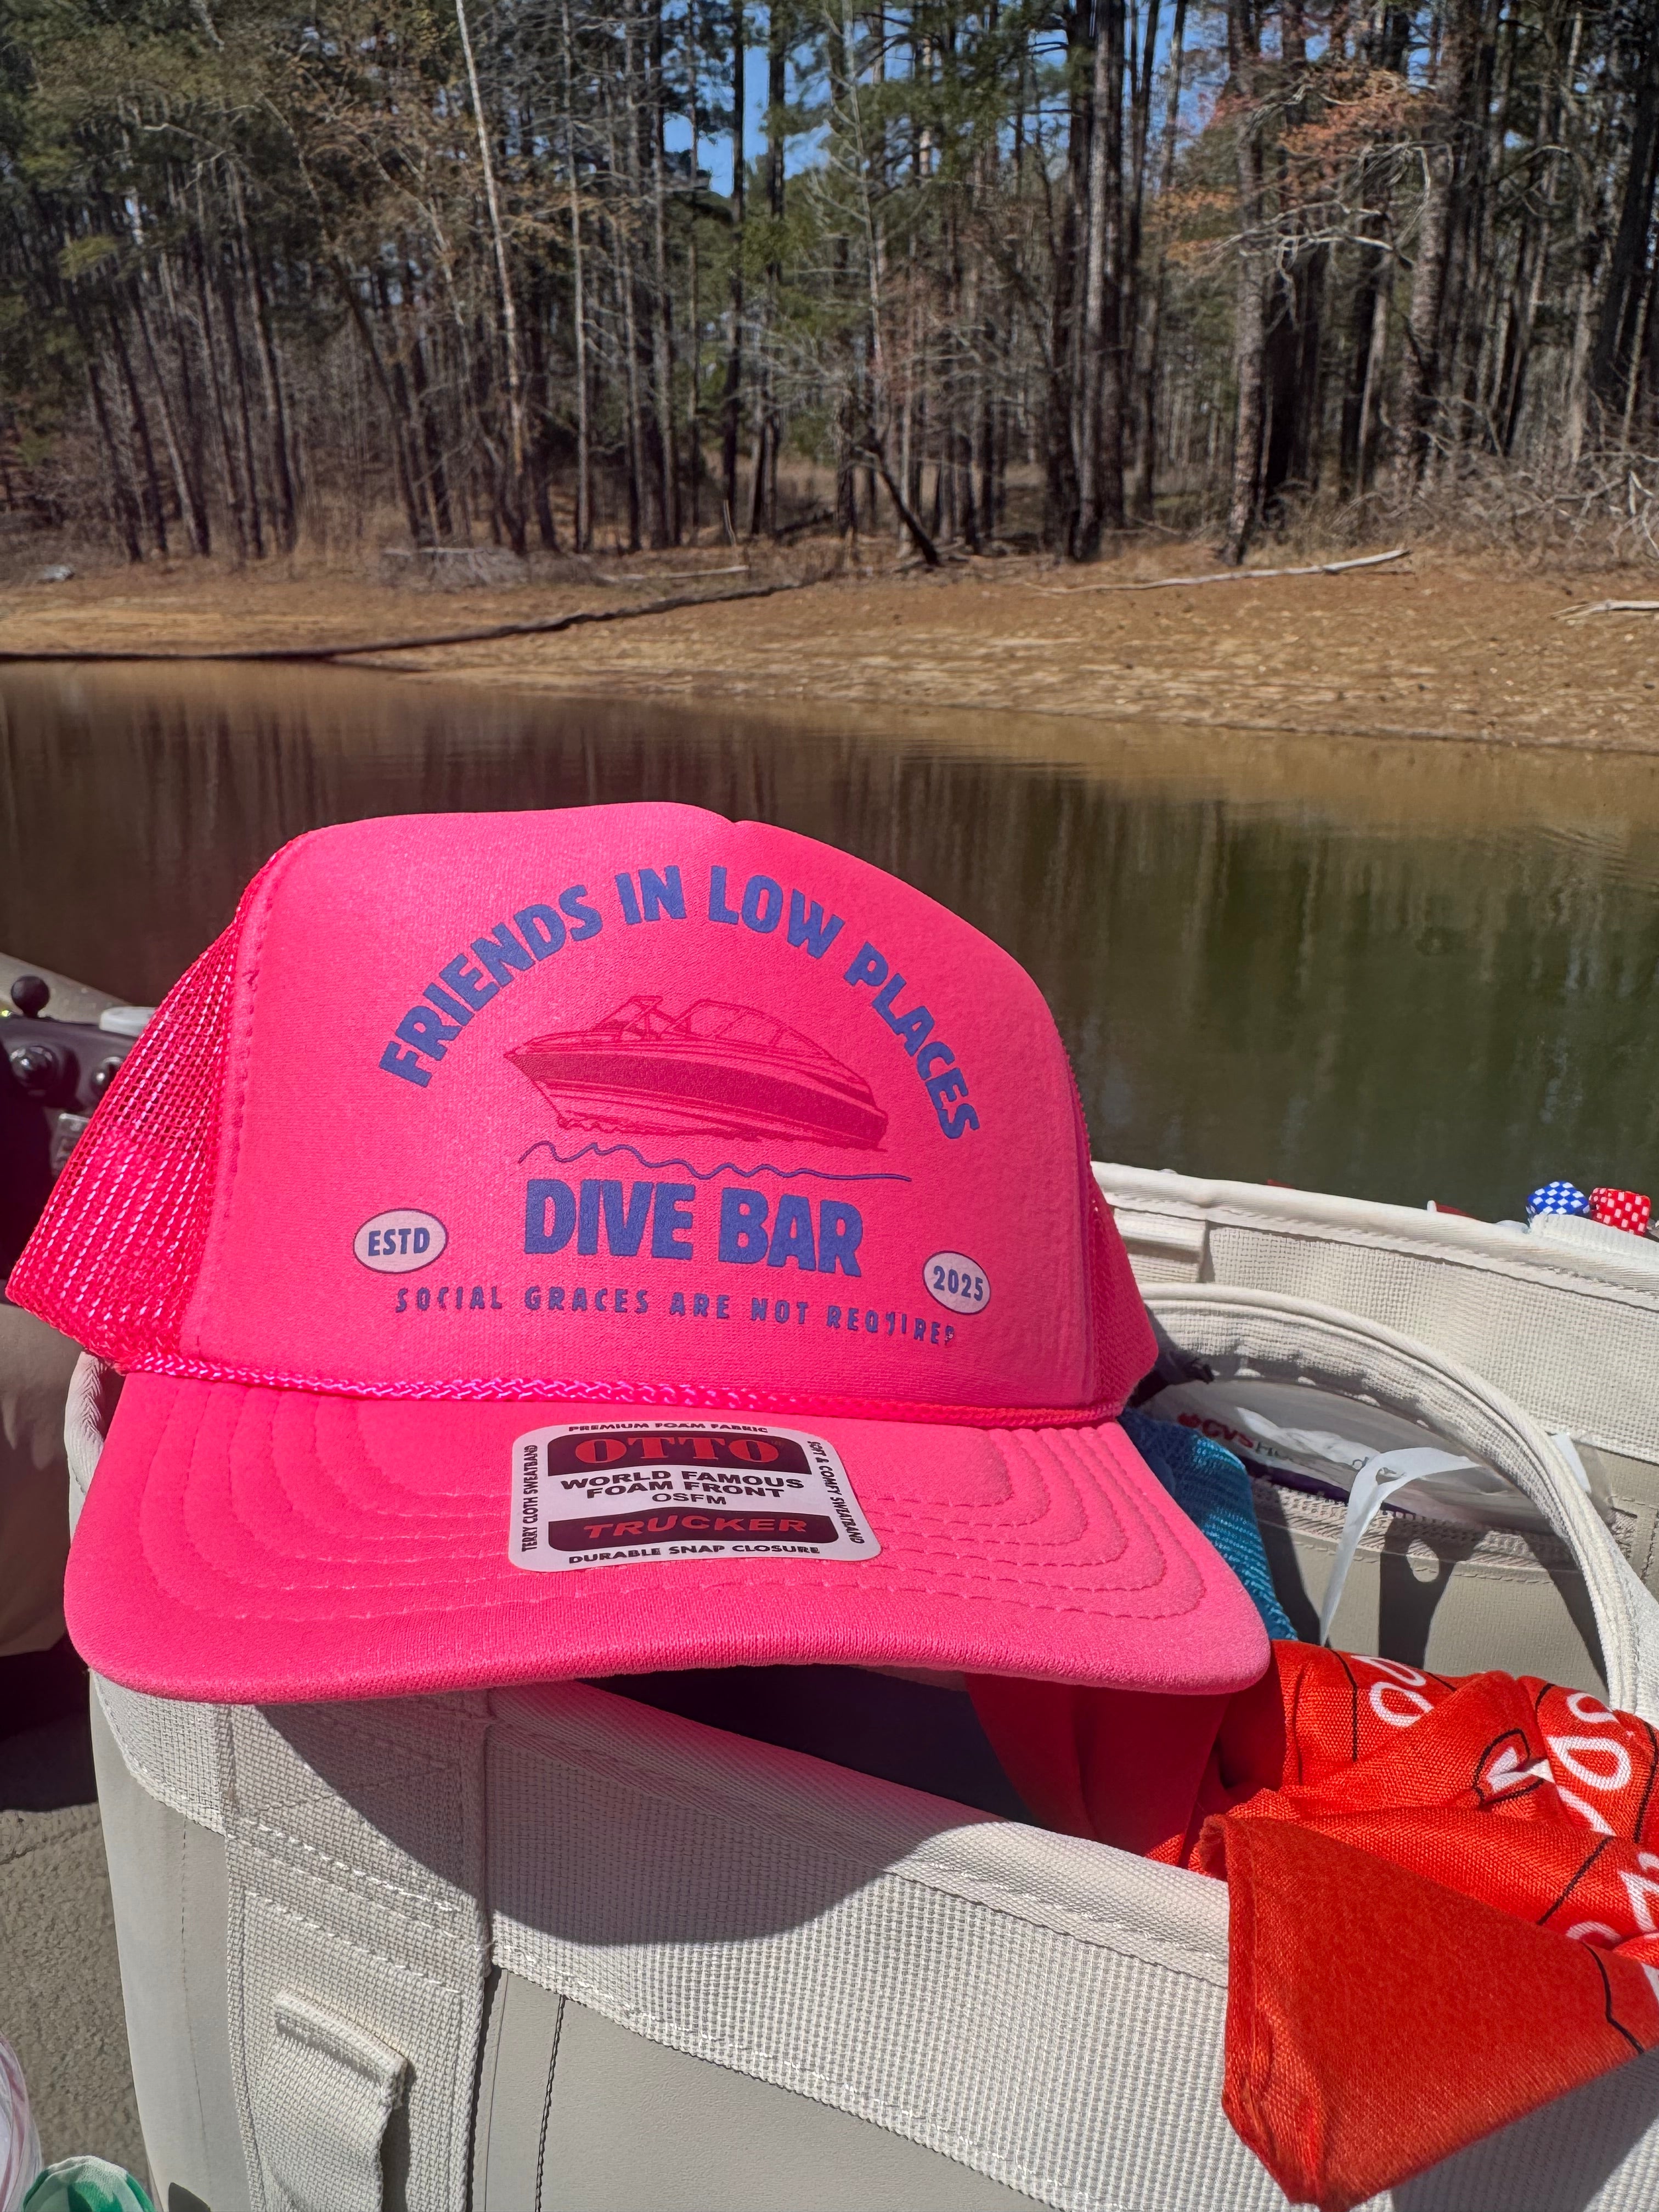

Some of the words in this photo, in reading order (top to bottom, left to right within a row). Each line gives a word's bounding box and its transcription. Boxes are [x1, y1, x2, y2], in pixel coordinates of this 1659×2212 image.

[379, 884, 603, 1087] FRIENDS
[614, 865, 686, 925] IN
[708, 865, 844, 959] LOW
[844, 943, 980, 1139] PLACES
[368, 1227, 430, 1256] ESTD
[524, 1179, 695, 1260] DIVE
[718, 1188, 863, 1277] BAR
[933, 1265, 983, 1301] 2025
[395, 1285, 503, 1313] SOCIAL
[524, 1286, 648, 1313] GRACES
[670, 1291, 730, 1319] ARE
[751, 1296, 809, 1325] NOT
[568, 1423, 650, 1432] PREMIUM
[710, 1423, 769, 1433] FABRIC
[575, 1436, 780, 1464] OTTO
[523, 1444, 539, 1495] SWEATBAND
[560, 1470, 672, 1490] WORLD
[680, 1470, 805, 1489] FAMOUS
[819, 1465, 843, 1496] COMFY
[586, 1481, 674, 1499] FOAM
[684, 1481, 785, 1498] FRONT
[652, 1493, 727, 1505] OSFM
[522, 1497, 539, 1524] CLOTH
[830, 1497, 865, 1544] SWEATBAND
[521, 1526, 538, 1552] TERRY
[583, 1515, 808, 1539] TRUCKER
[568, 1547, 661, 1564] DURABLE
[668, 1544, 725, 1555] SNAP
[731, 1544, 820, 1554] CLOSURE
